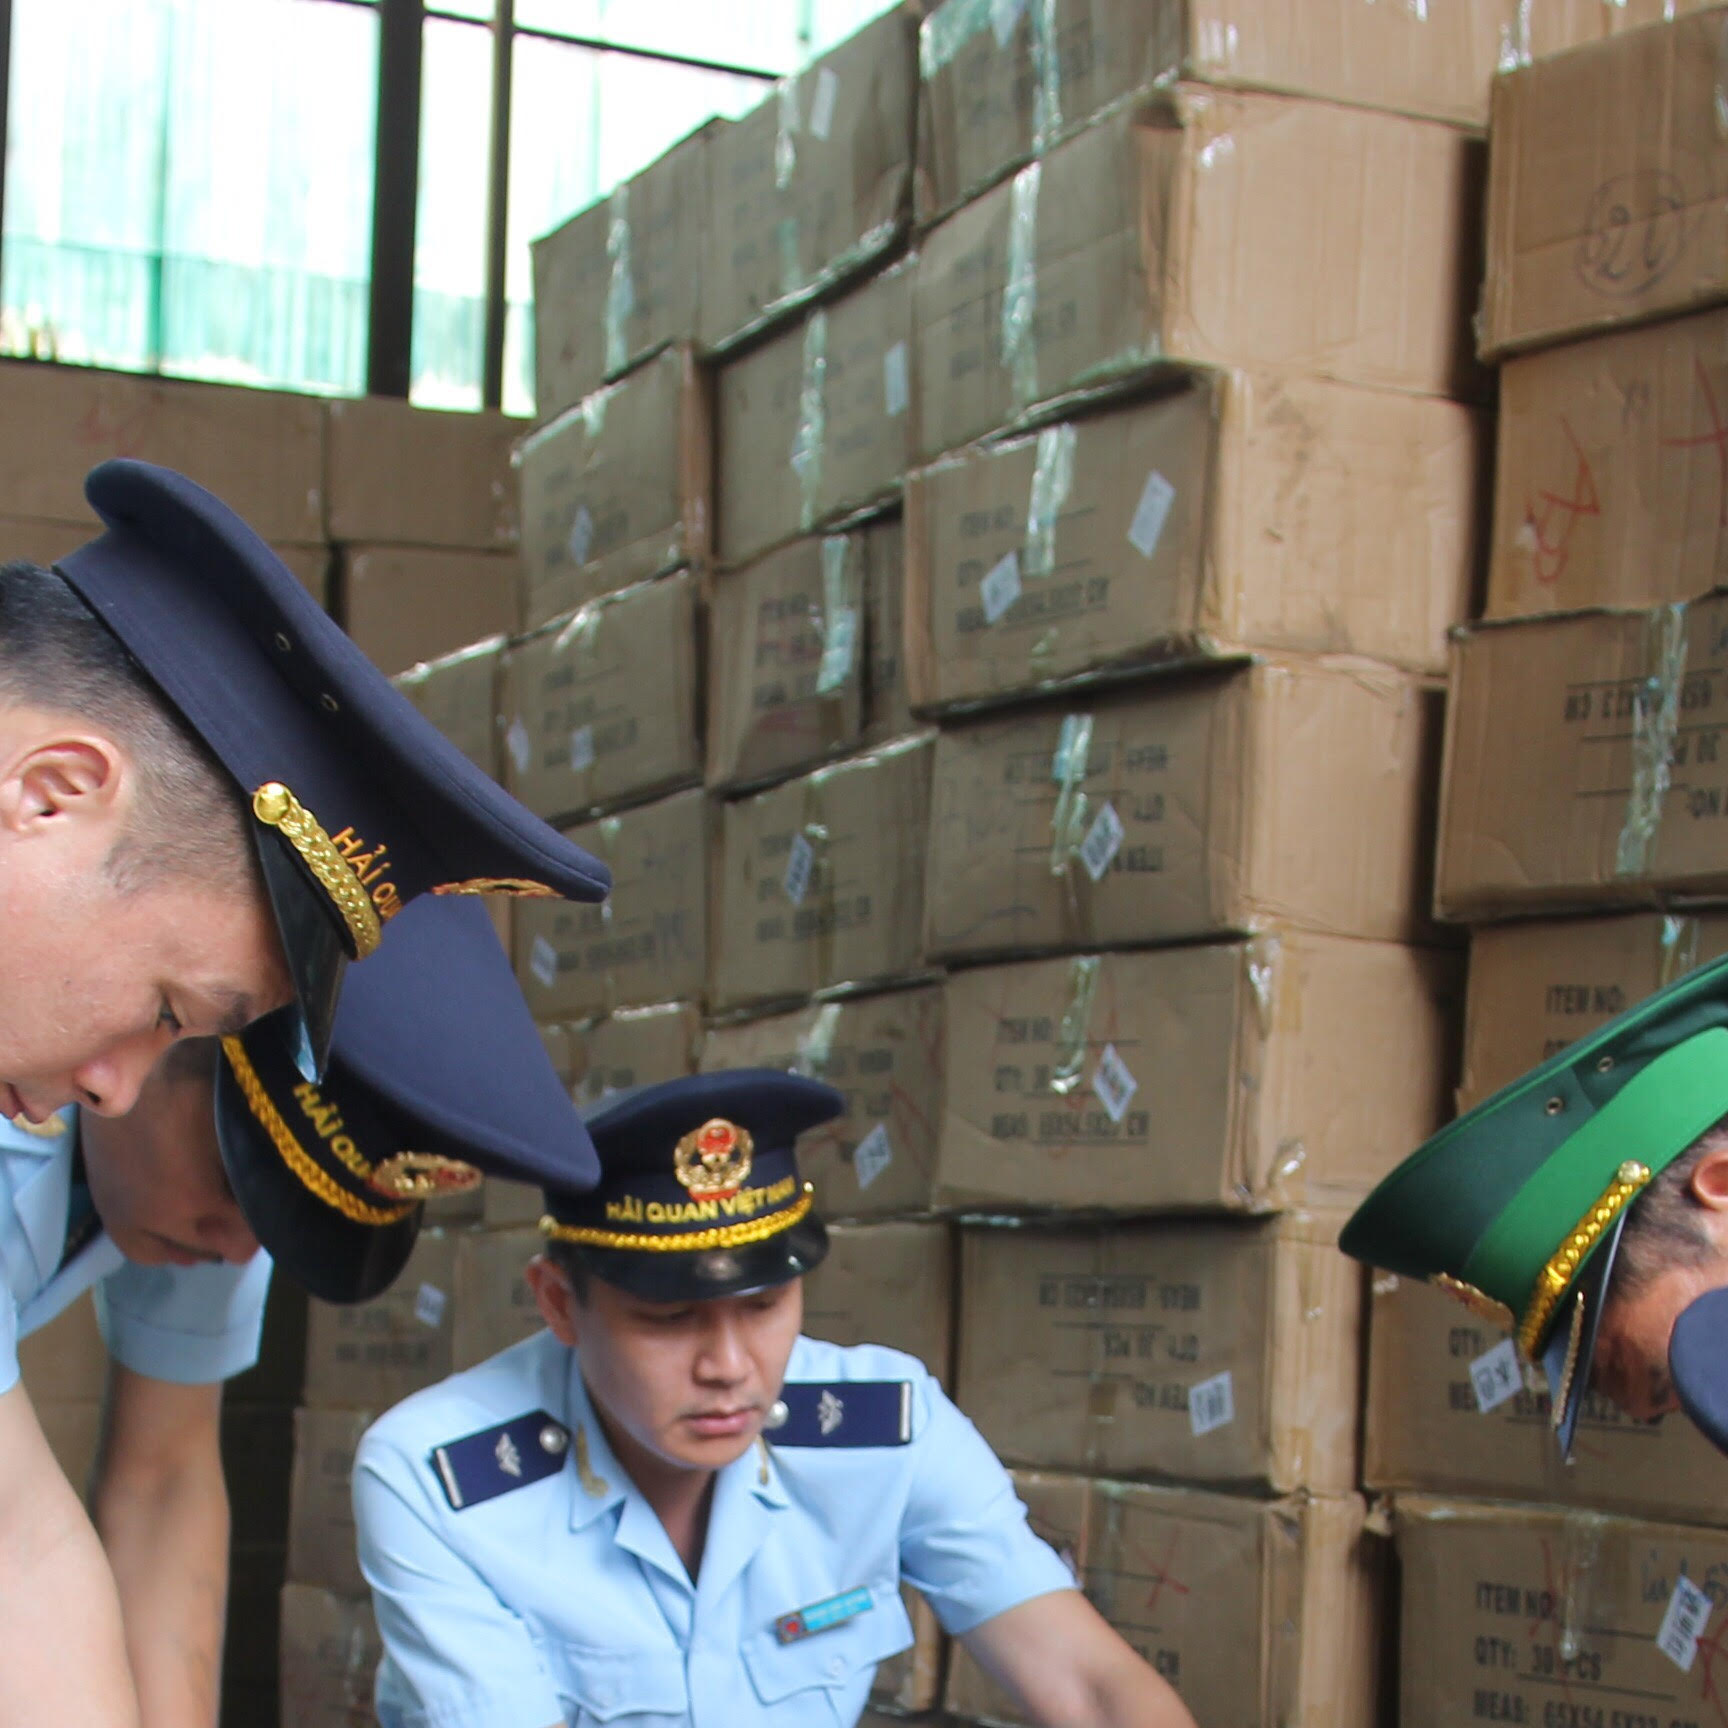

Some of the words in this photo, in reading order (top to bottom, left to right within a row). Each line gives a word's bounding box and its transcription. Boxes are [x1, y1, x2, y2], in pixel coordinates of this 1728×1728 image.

[332, 826, 391, 886] HẢI
[606, 1193, 644, 1223] HẢI
[645, 1199, 719, 1224] QUAN
[1476, 1579, 1521, 1616] ITEM
[1476, 1634, 1516, 1669] QTY:
